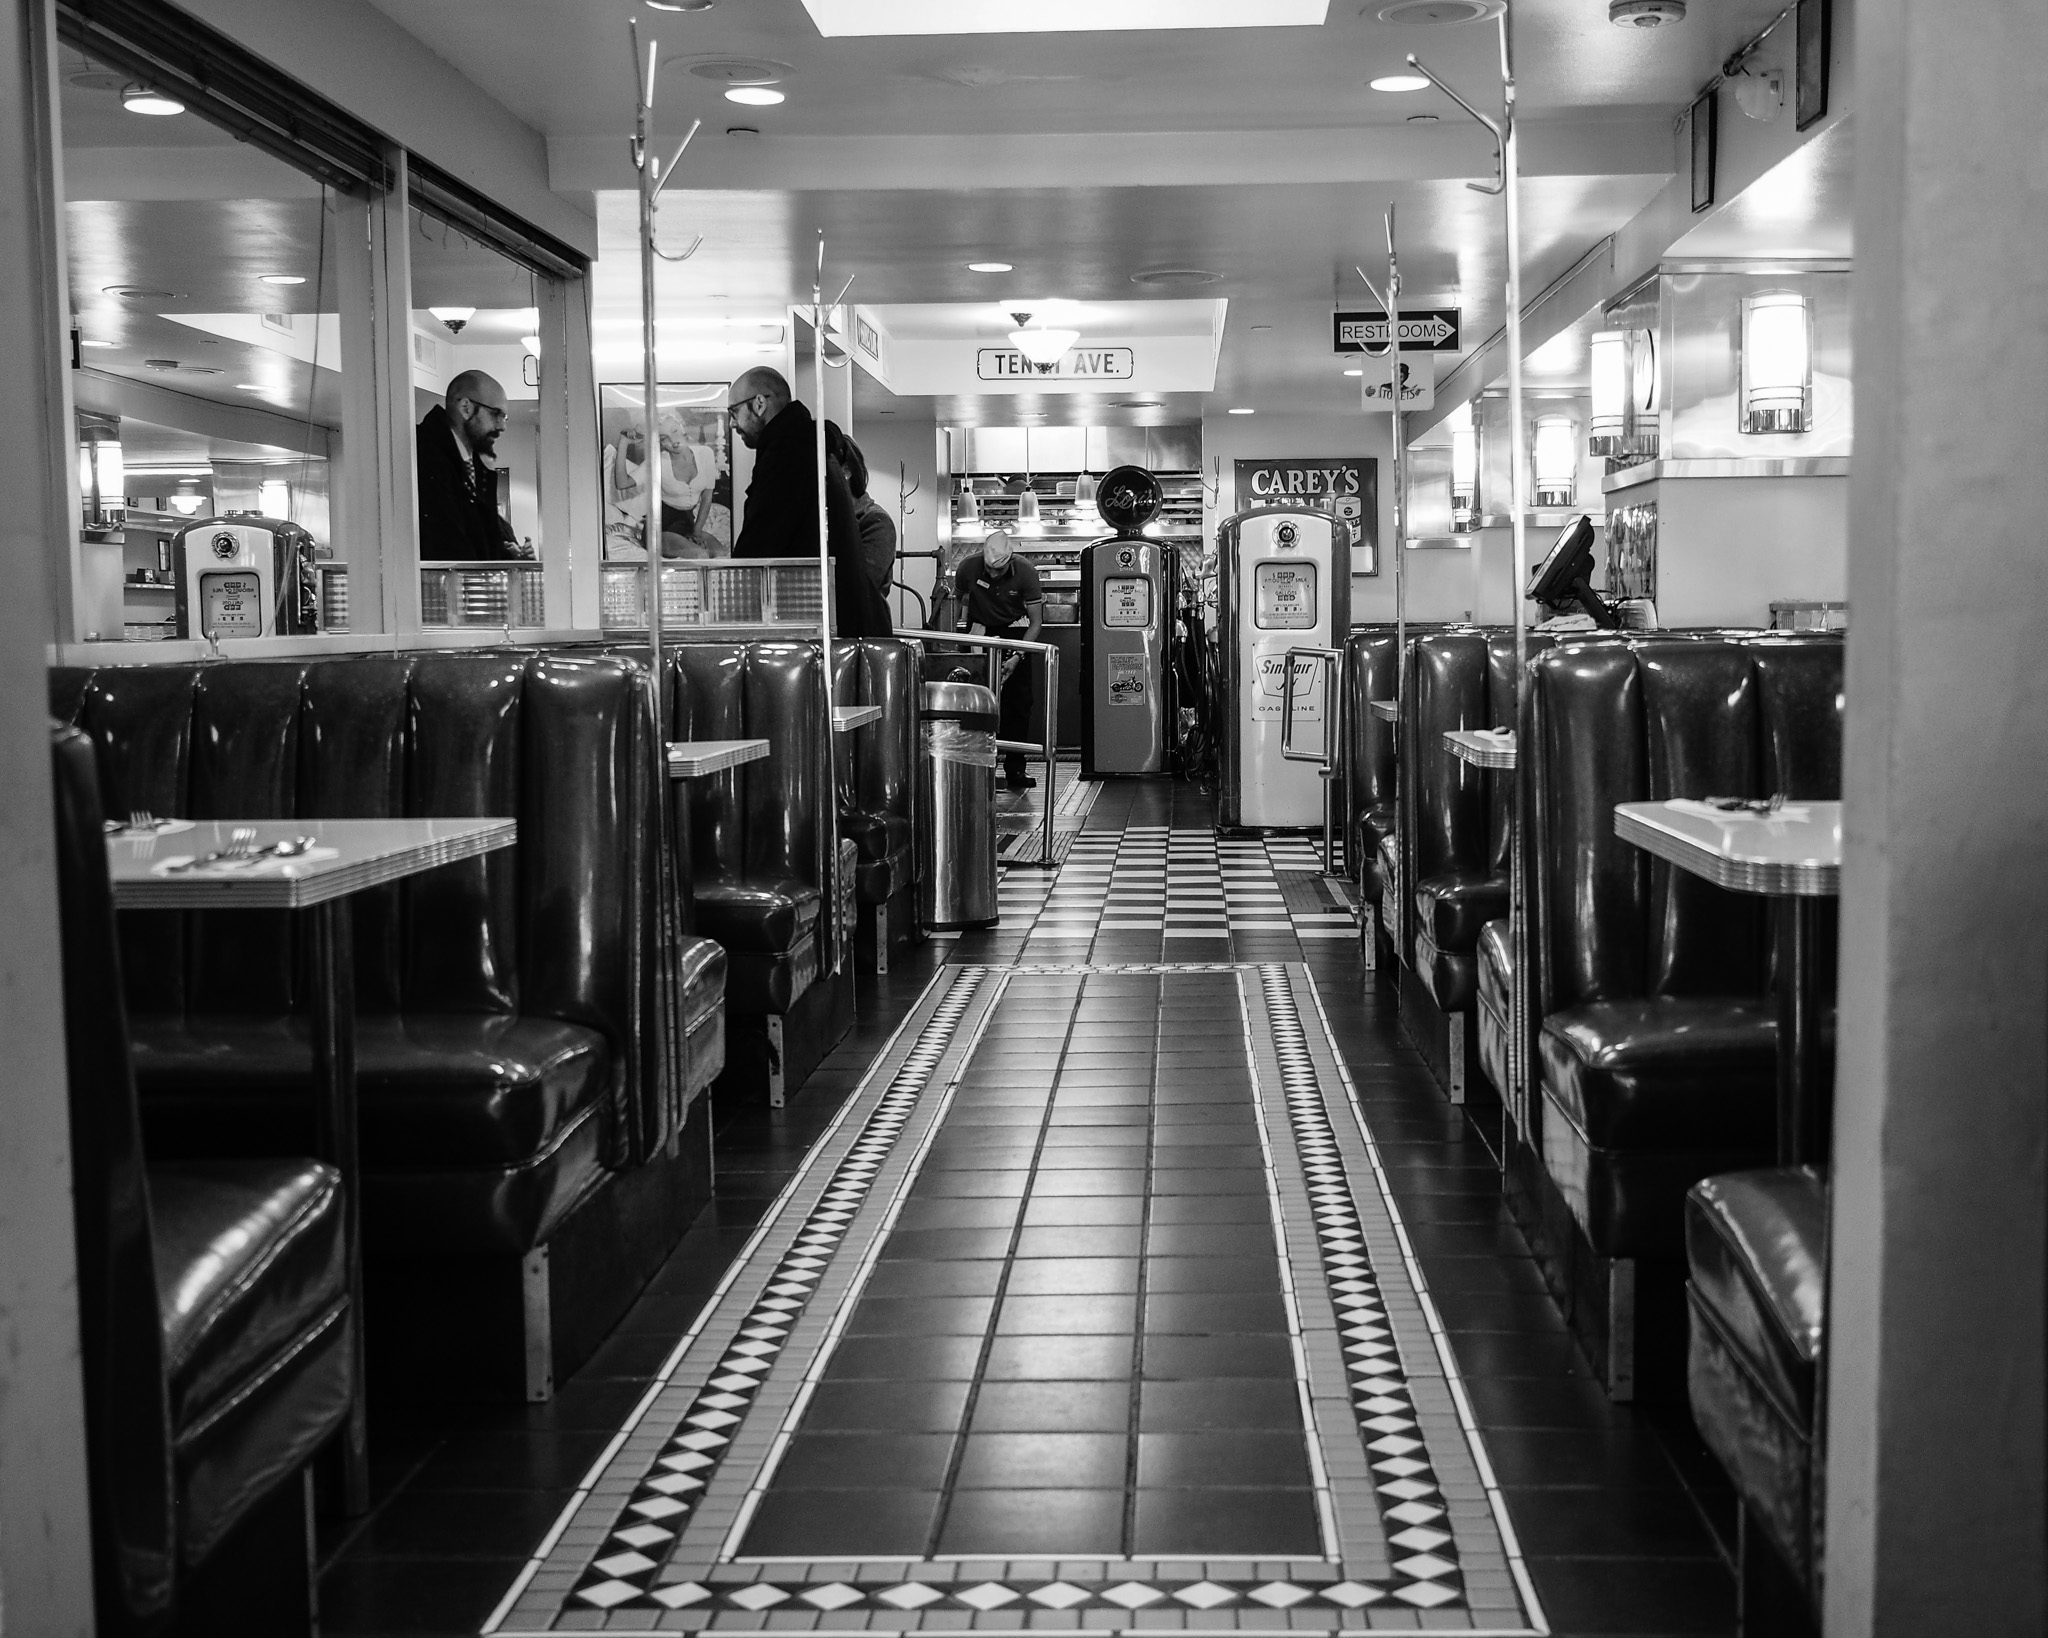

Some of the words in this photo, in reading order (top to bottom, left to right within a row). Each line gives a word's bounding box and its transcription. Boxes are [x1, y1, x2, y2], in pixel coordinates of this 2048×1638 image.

[1342, 324, 1447, 339] RESTOOMS
[994, 354, 1060, 374] TEN
[1073, 353, 1120, 374] AVE.
[1382, 388, 1416, 400] TOETS
[1251, 465, 1360, 495] CAREY'S
[1261, 660, 1313, 674] Sinair
